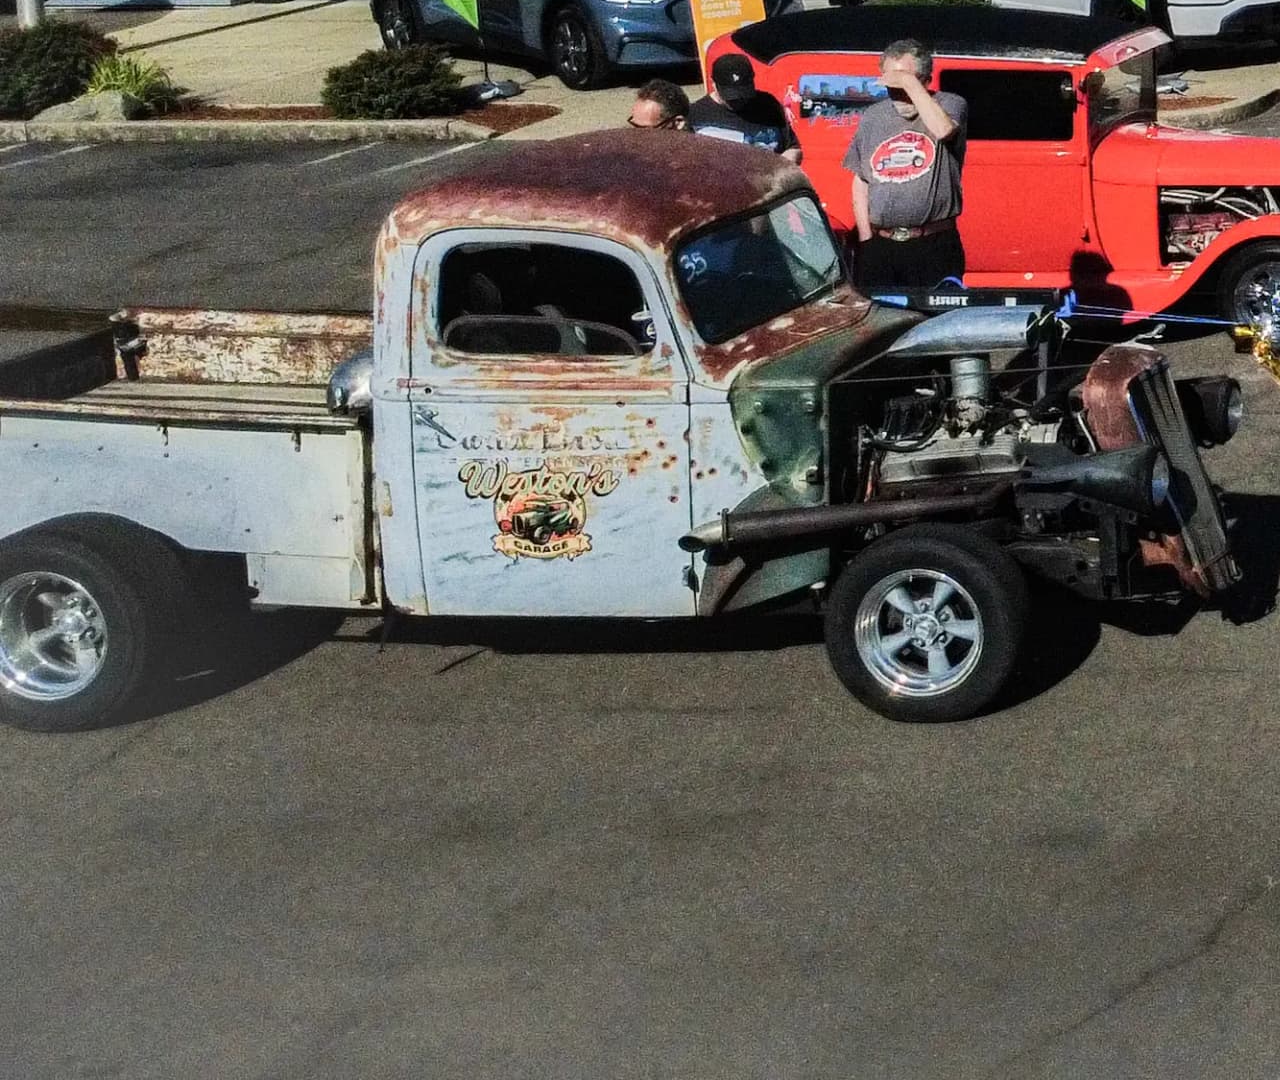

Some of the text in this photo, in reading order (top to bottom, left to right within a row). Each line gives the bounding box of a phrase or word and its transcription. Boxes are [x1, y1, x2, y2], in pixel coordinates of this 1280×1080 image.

[680, 252, 708, 283] 35
[459, 460, 622, 499] Weston's
[512, 539, 570, 554] GARAGE
